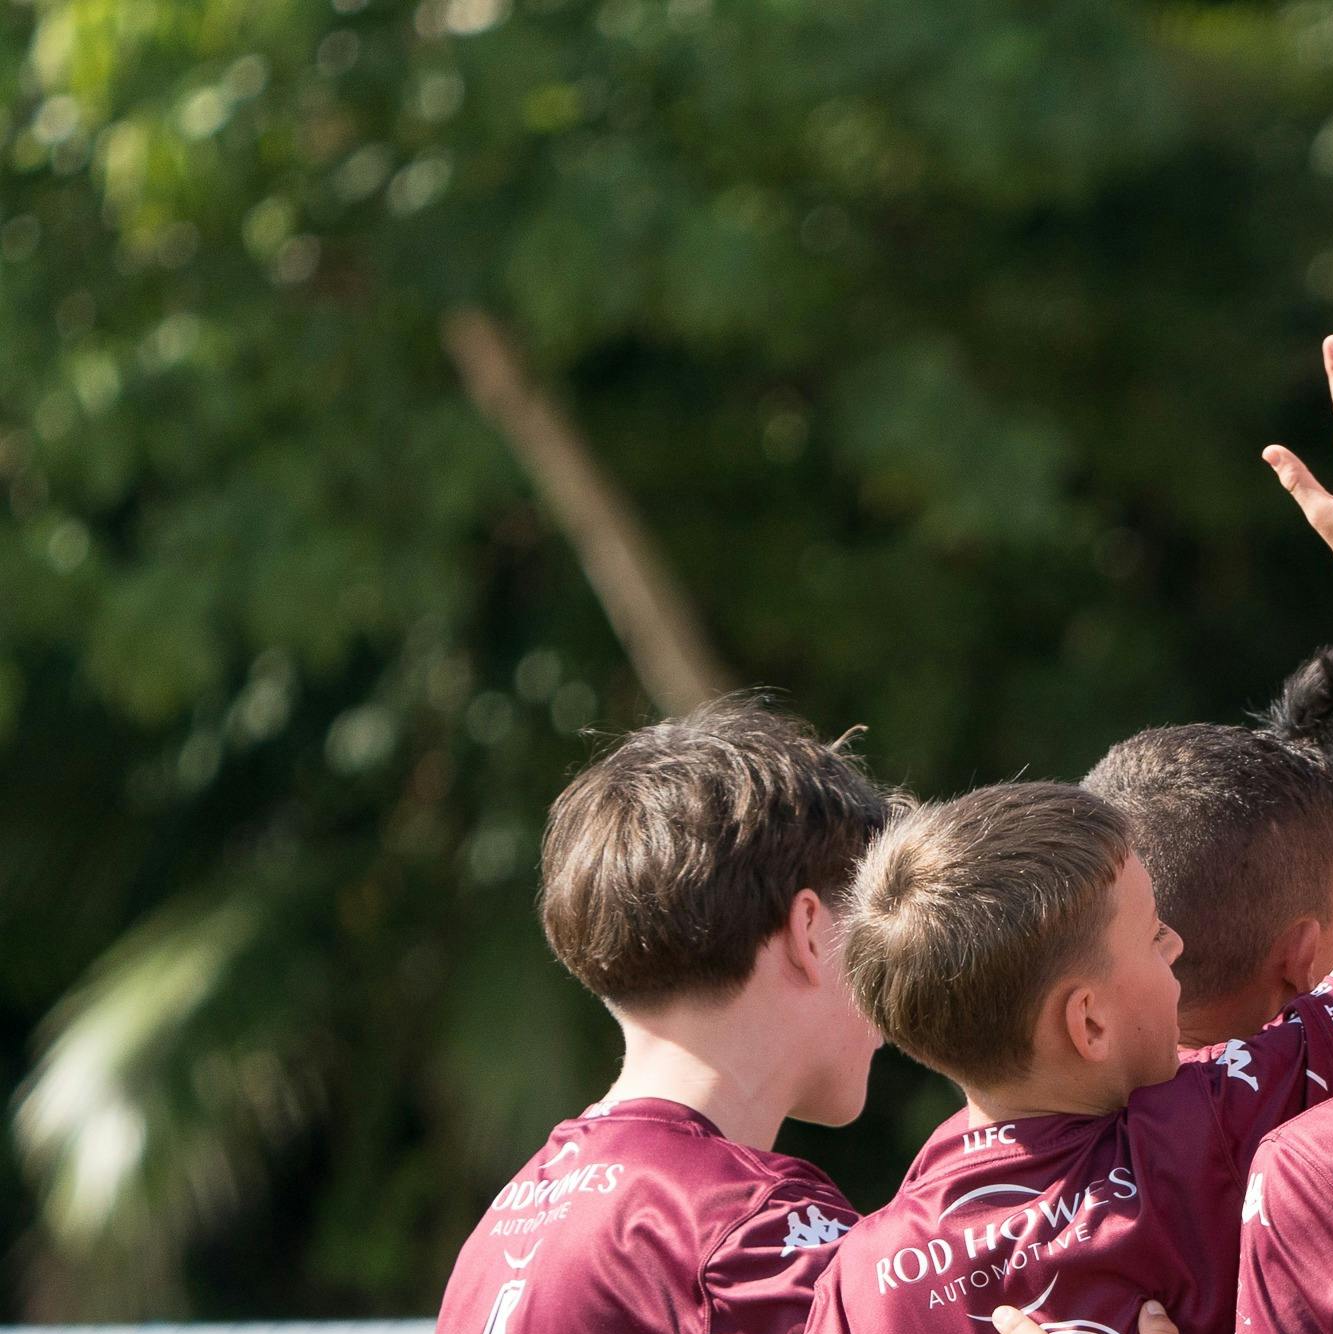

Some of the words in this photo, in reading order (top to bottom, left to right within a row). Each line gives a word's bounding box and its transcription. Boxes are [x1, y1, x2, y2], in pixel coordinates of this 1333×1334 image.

[963, 1124, 1017, 1154] LLFC
[875, 1238, 954, 1296] ROD
[963, 1167, 1138, 1260] HOWES
[928, 1222, 1092, 1309] AUTOMOTIVE
